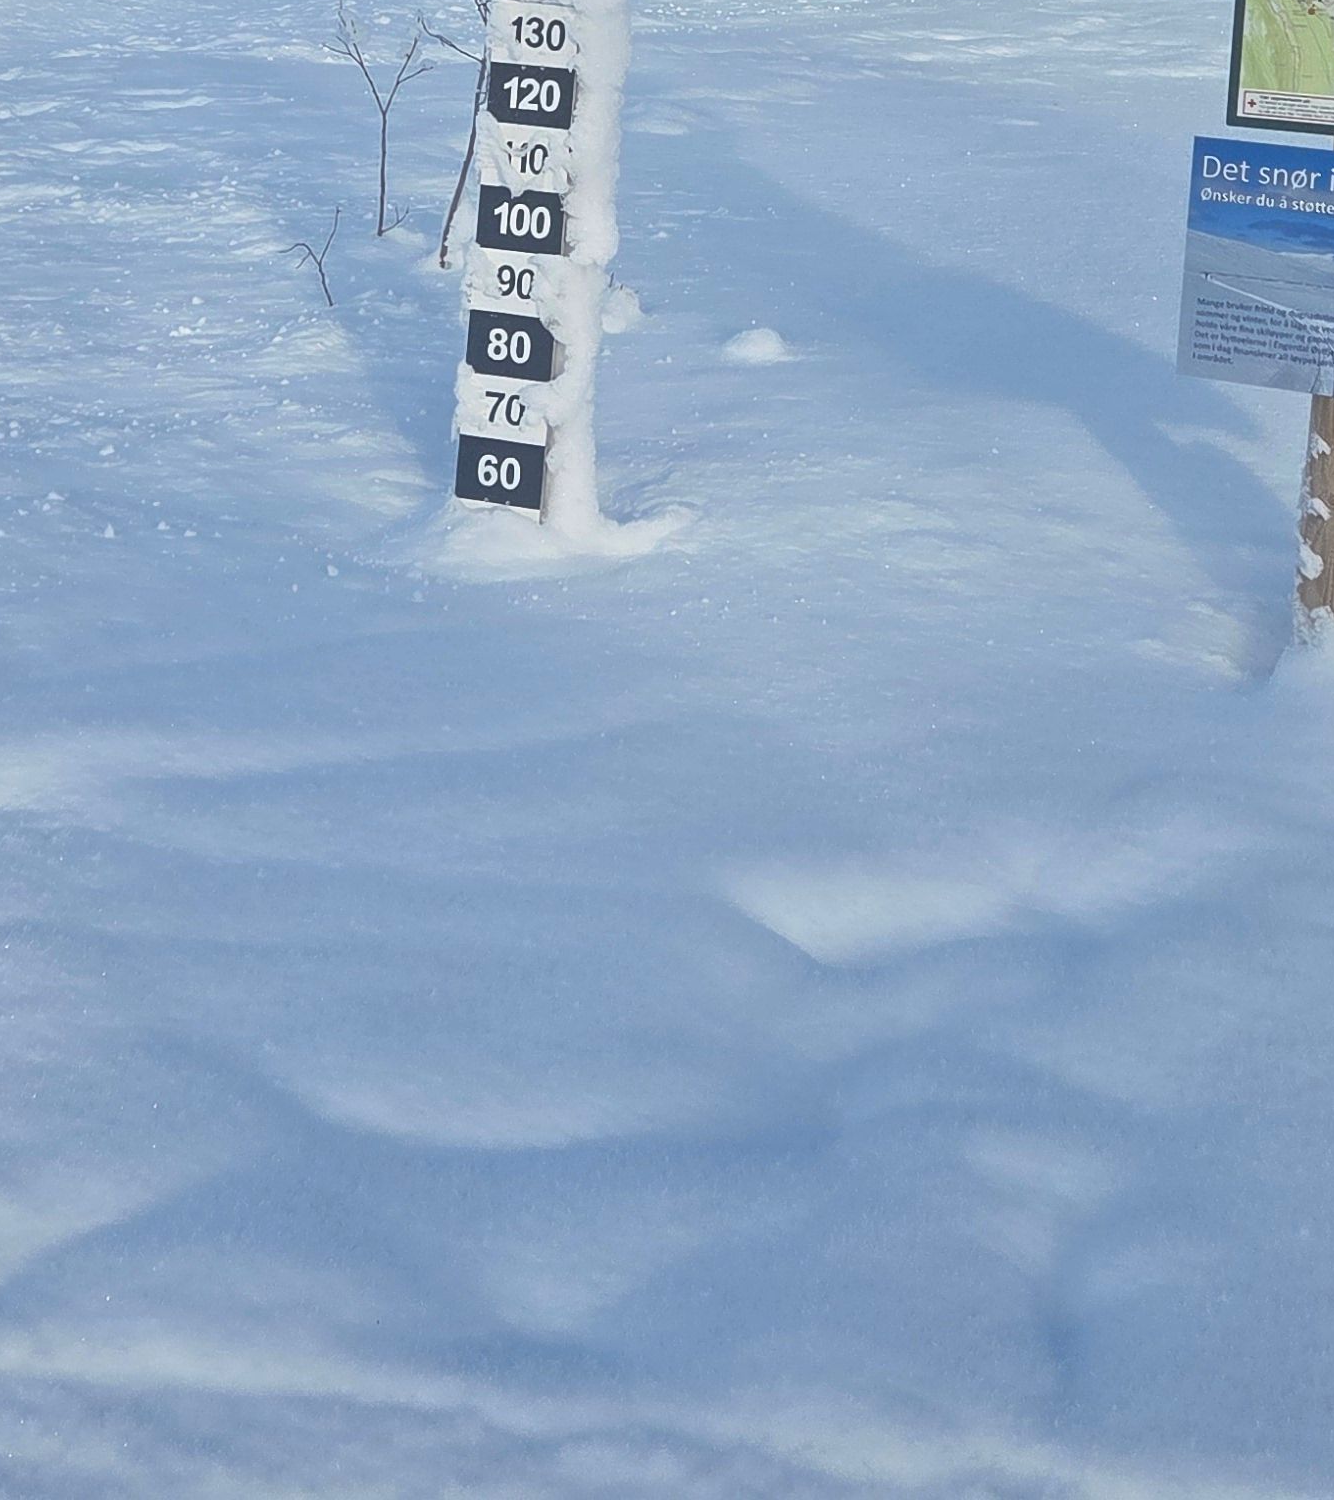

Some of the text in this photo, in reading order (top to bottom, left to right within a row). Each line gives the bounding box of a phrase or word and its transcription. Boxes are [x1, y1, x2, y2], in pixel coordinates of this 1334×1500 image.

[512, 16, 566, 51] 130
[503, 76, 561, 113] 120
[1203, 155, 1251, 182] Det
[1258, 166, 1322, 190] snør
[1200, 187, 1252, 204] Ønsker
[1256, 194, 1275, 208] du
[1278, 195, 1288, 209] å
[494, 201, 551, 239] 100
[497, 264, 535, 300] 90
[487, 328, 531, 364] 80
[485, 391, 526, 426] 70
[477, 454, 521, 490] 60
